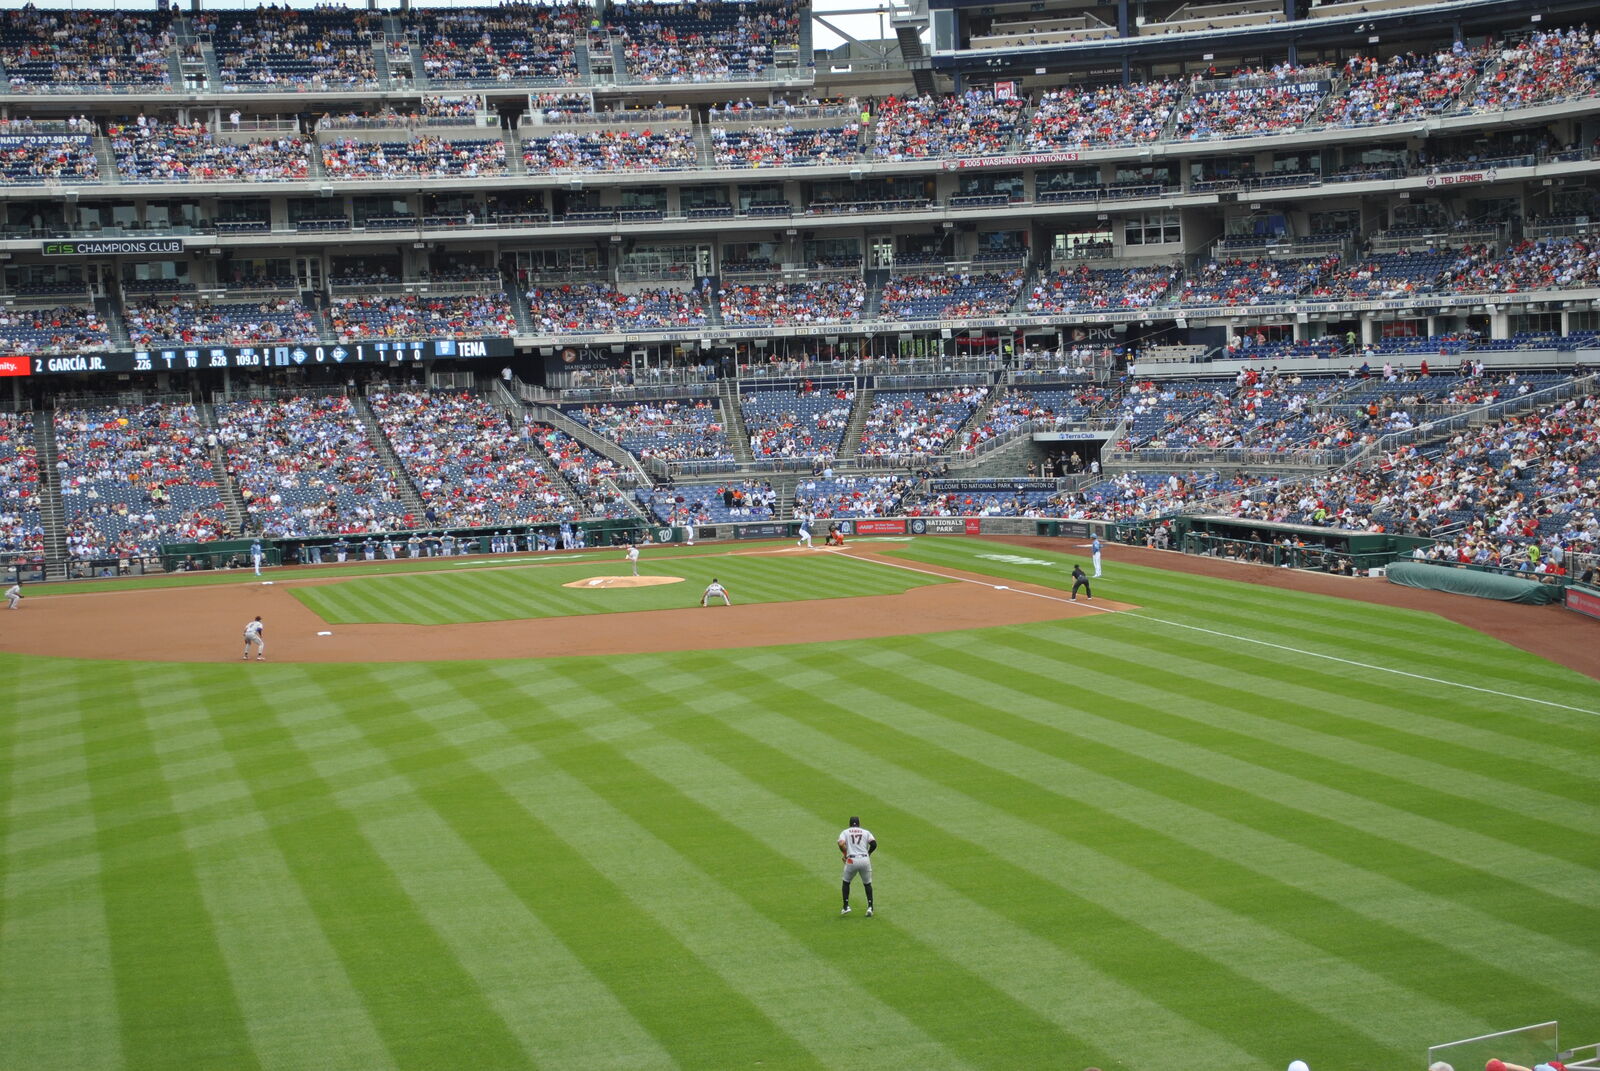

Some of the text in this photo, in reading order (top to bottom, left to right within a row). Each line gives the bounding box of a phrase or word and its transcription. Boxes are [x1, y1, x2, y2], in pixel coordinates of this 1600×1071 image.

[1299, 83, 1318, 92] WOO!
[981, 157, 1033, 166] WASHINGTON
[1034, 153, 1076, 163] NATIONALS
[1455, 174, 1483, 183] LERNER
[77, 243, 146, 254] CHAMPIONS
[149, 242, 179, 252] CLUB
[1089, 328, 1117, 340] PNC
[315, 347, 324, 362] 0
[356, 345, 363, 360] 1
[413, 349, 420, 360] 0
[458, 341, 487, 357] TENA
[579, 348, 608, 361] PNC
[235, 355, 259, 366] 109.0
[380, 351, 384, 361] 1
[396, 350, 403, 360] 0
[35, 355, 106, 372] 2 GARCÍA JR.
[133, 360, 152, 370] .226
[166, 358, 172, 368] 1
[186, 357, 197, 367] 10
[209, 356, 227, 367] .628
[851, 834, 863, 845] 17
